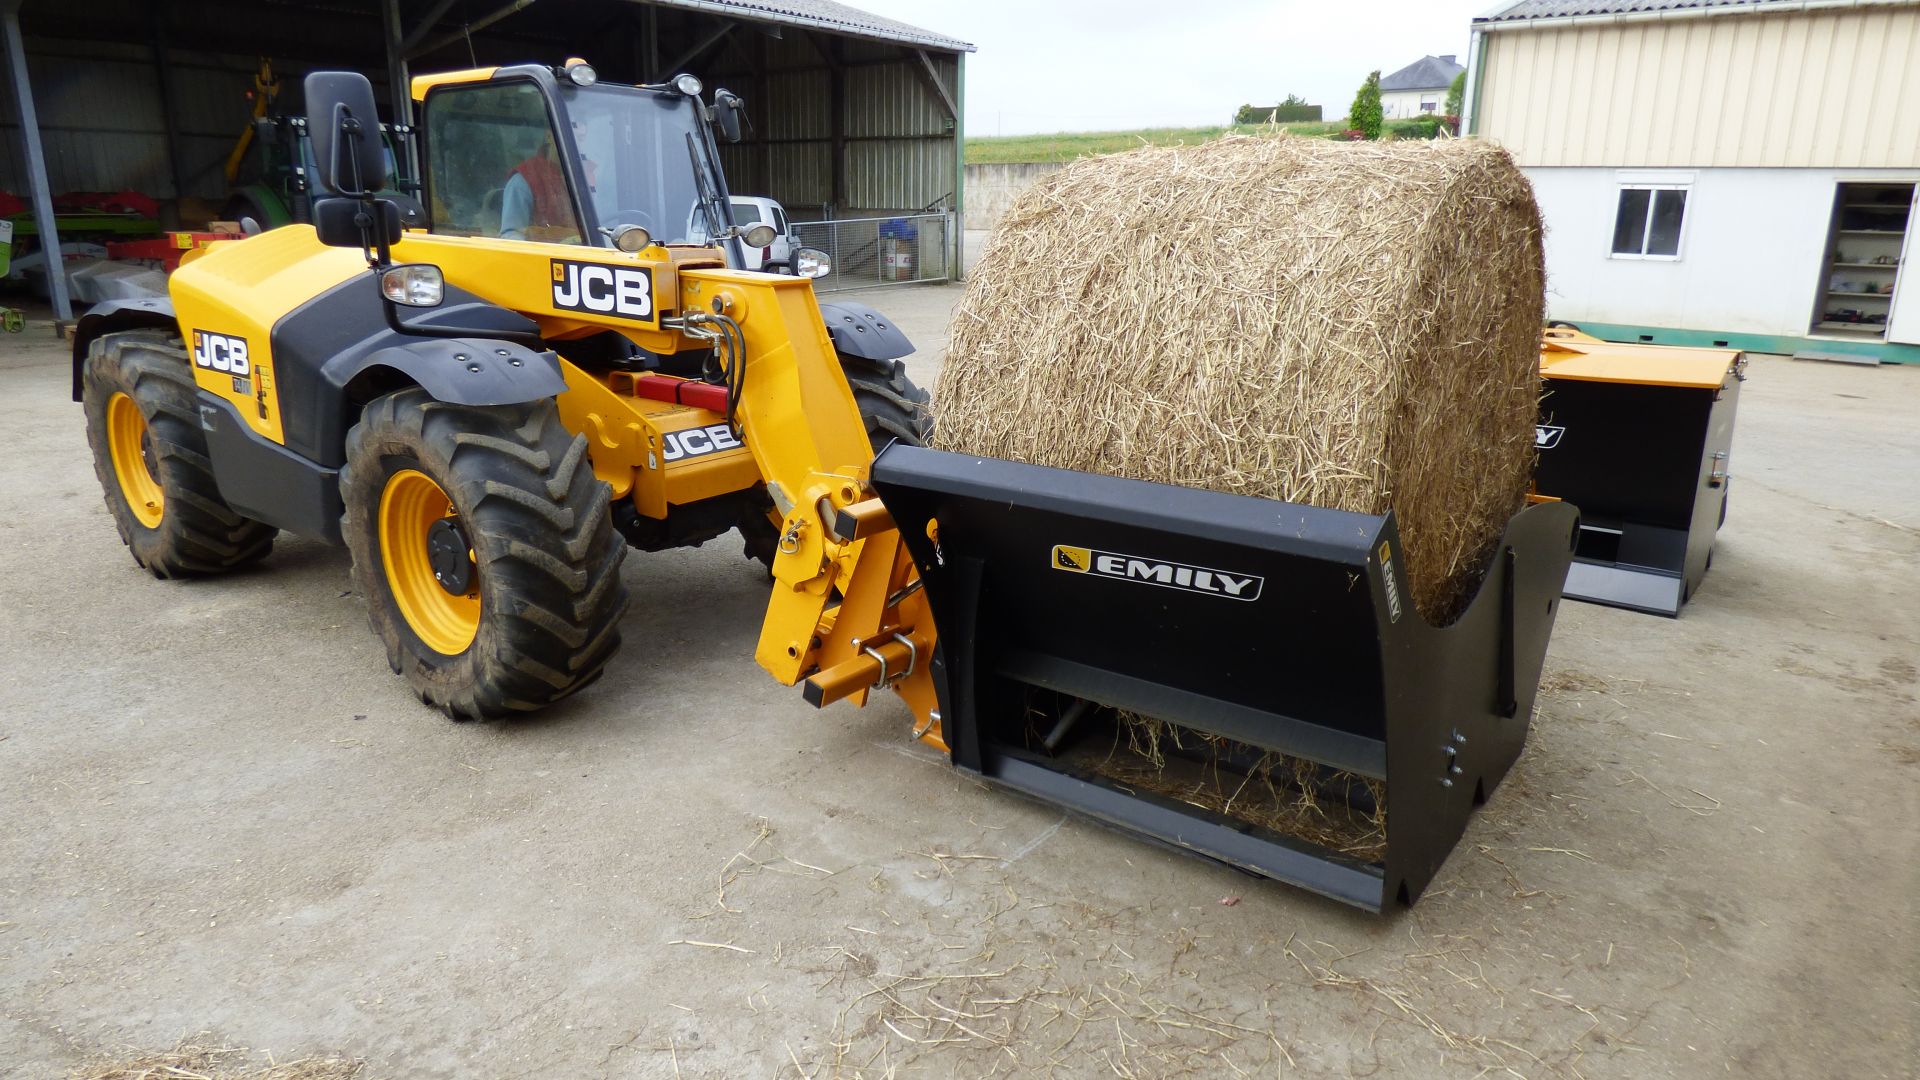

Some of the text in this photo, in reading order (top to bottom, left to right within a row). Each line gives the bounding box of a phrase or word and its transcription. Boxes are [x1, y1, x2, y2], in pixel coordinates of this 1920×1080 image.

[554, 264, 651, 316] JCB
[195, 333, 250, 375] JCB
[663, 424, 741, 460] JCB
[1097, 555, 1253, 595] EMILY
[1384, 560, 1400, 617] EMILY
